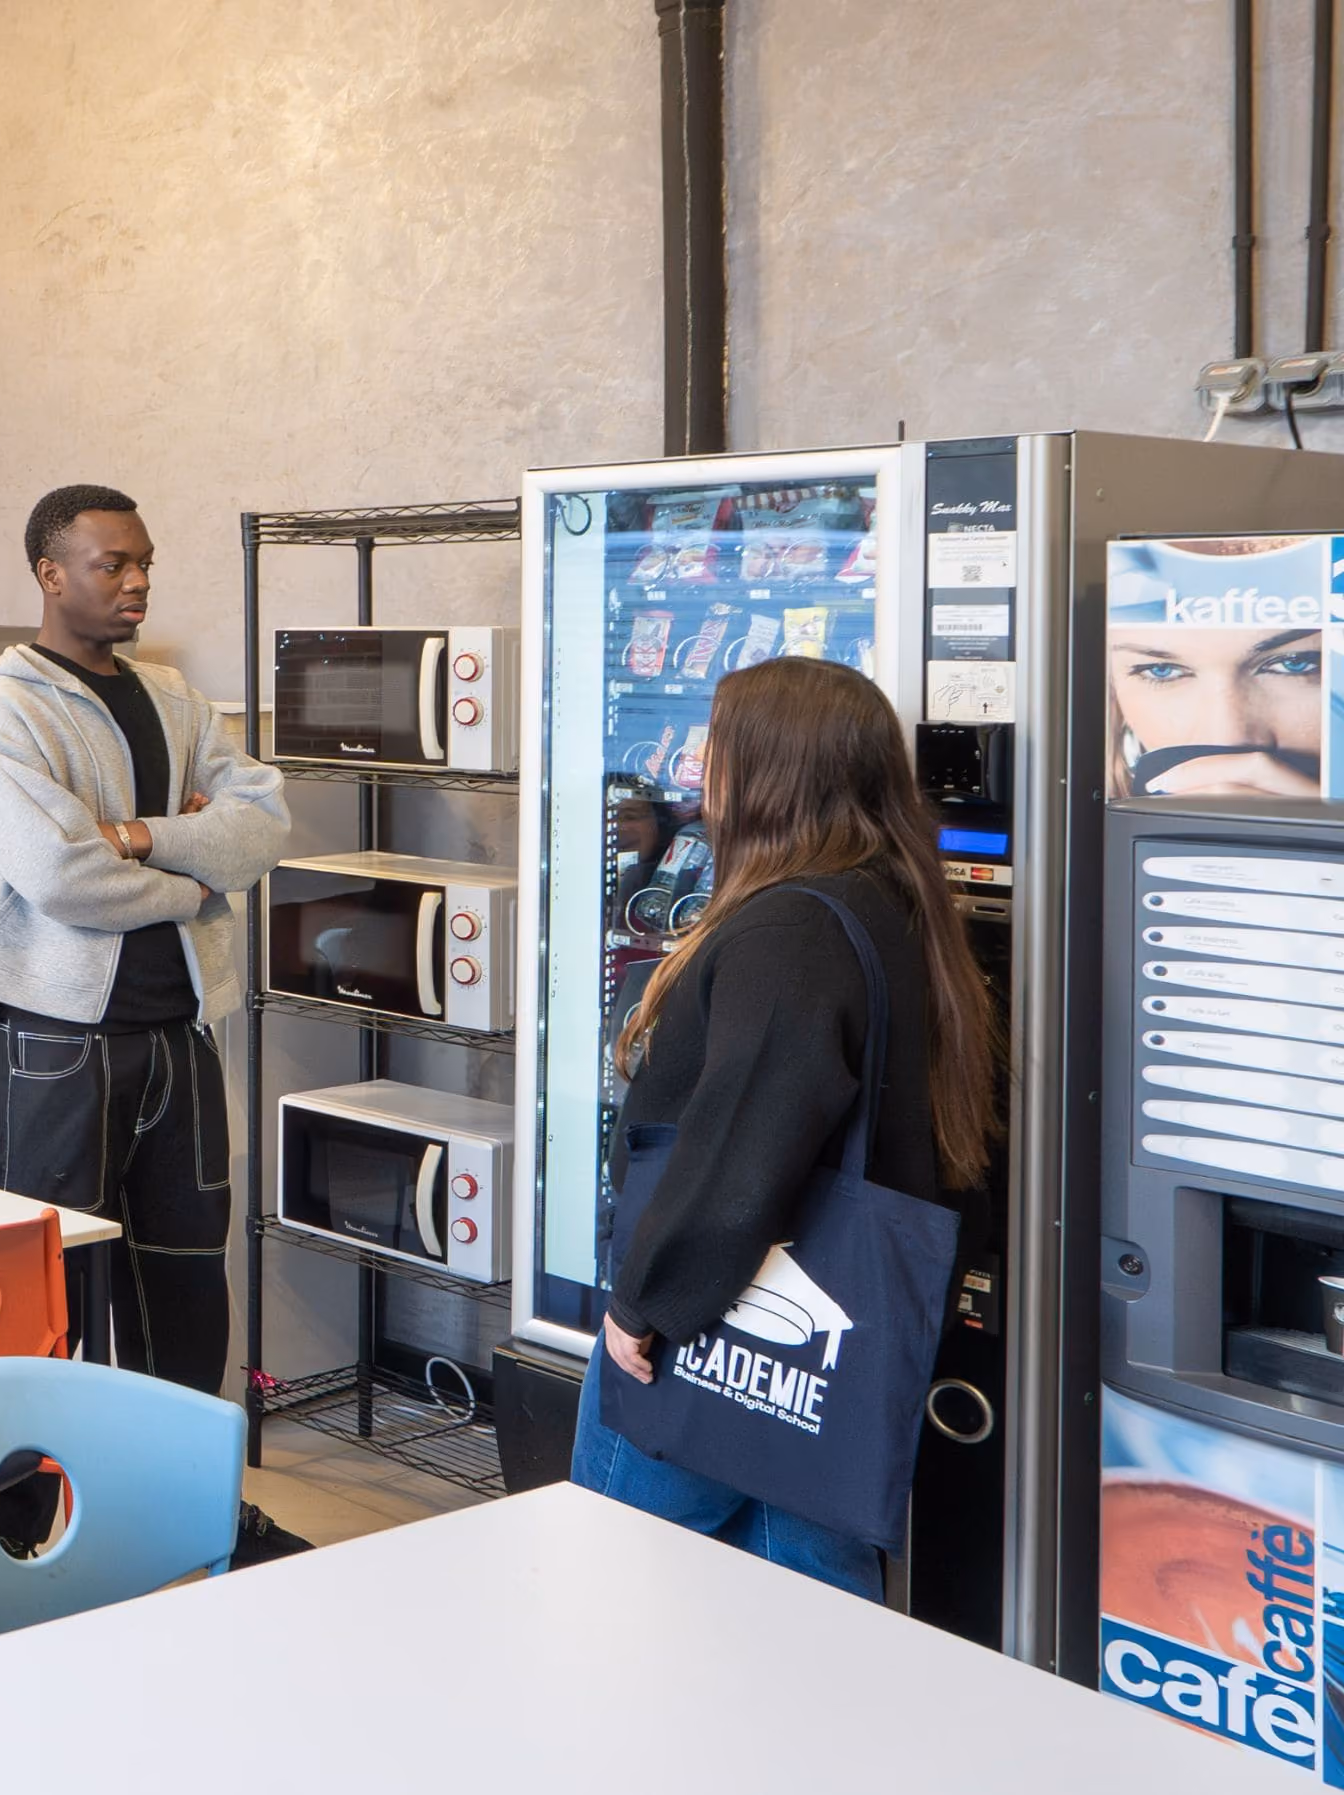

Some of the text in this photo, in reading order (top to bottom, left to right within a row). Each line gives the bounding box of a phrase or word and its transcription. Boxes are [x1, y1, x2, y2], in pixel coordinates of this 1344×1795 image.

[931, 500, 1012, 516] Snakky Max
[1166, 587, 1320, 624] kaffee
[673, 1365, 820, 1435] Business & Digital School
[1246, 1524, 1314, 1683] caffè
[1104, 1638, 1315, 1758] café
